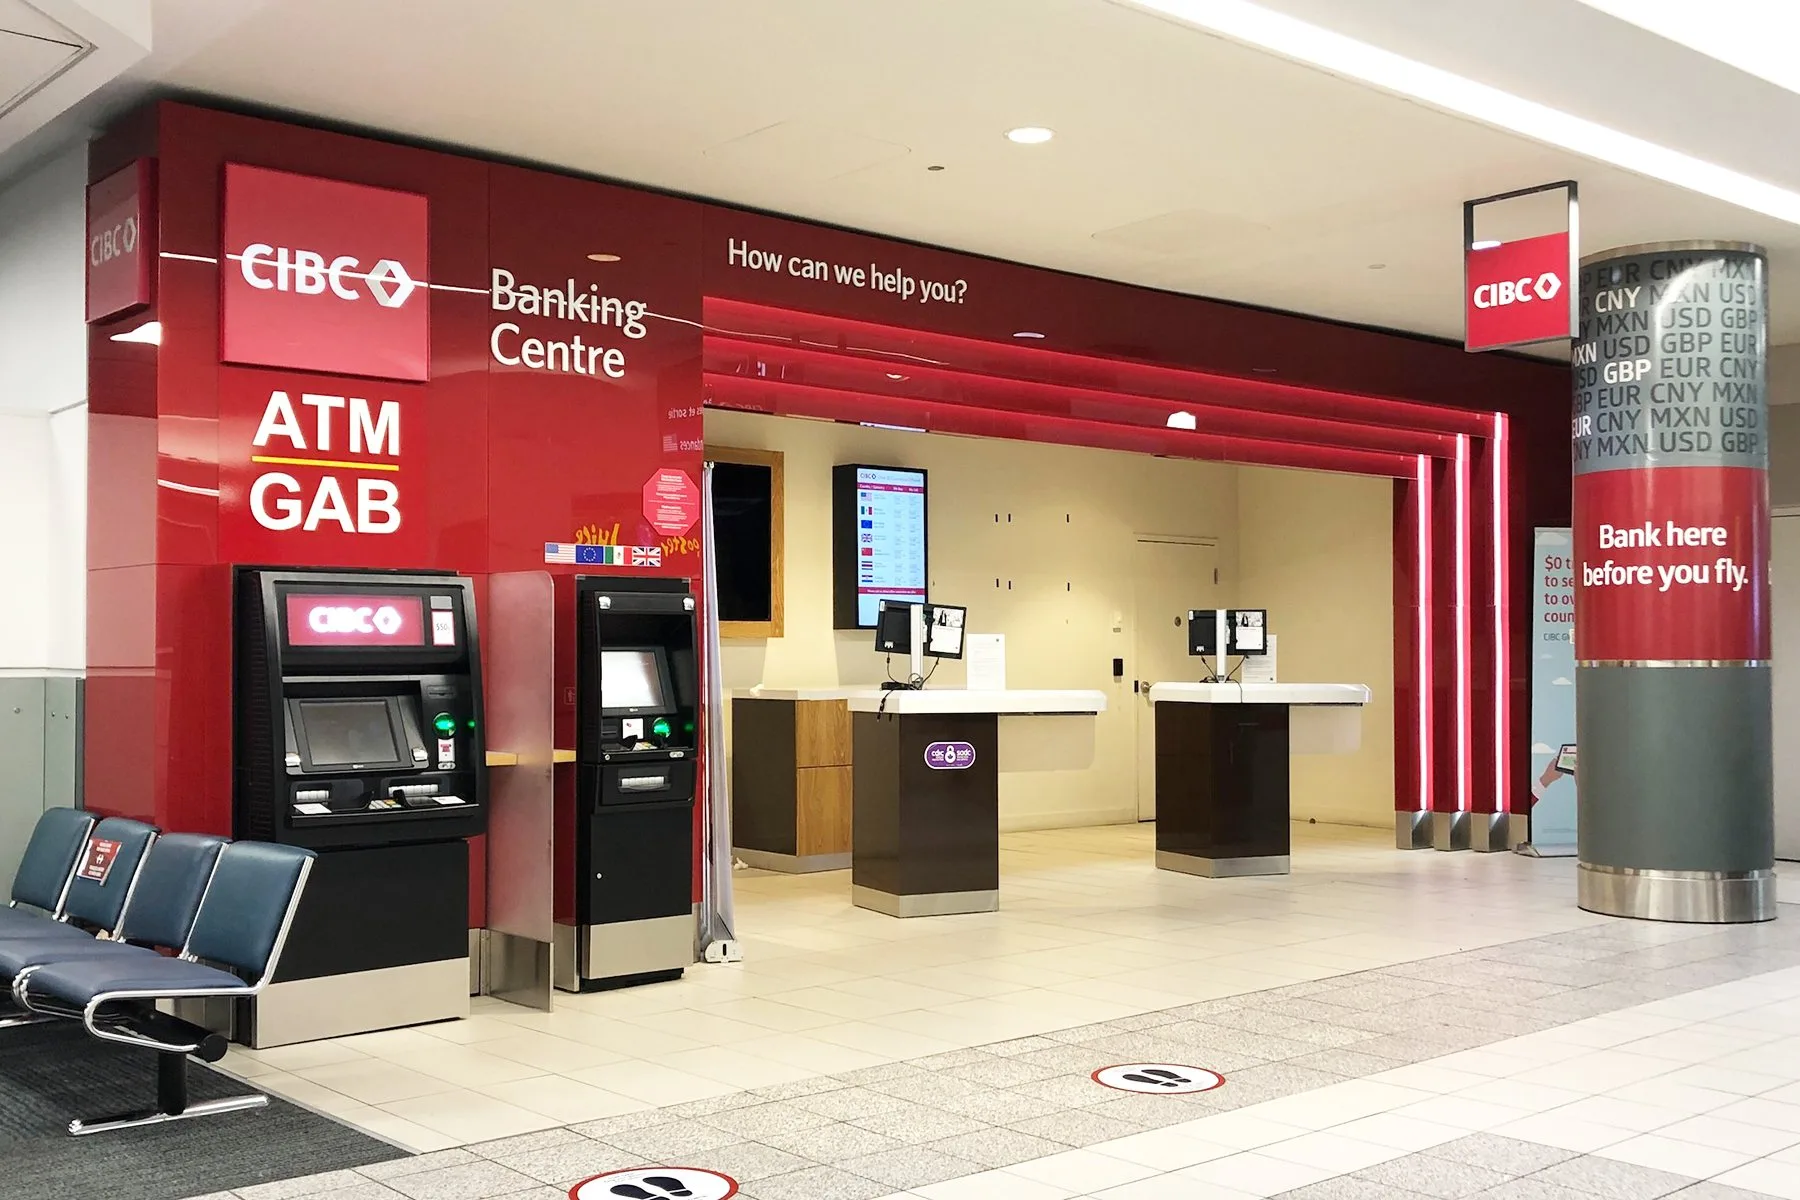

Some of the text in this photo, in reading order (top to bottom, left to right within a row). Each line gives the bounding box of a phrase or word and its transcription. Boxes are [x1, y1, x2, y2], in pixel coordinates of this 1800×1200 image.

[91, 224, 122, 267] CIBC
[241, 243, 360, 301] CIBC
[728, 238, 968, 304] How can we help you?
[1650, 257, 1703, 282] CN
[492, 268, 647, 339] Banking
[1473, 277, 1533, 309] CIBC
[1595, 286, 1641, 313] CNY
[1597, 310, 1648, 335] MXN
[1721, 308, 1757, 330] GBP
[490, 322, 625, 378] Centre
[1604, 335, 1650, 359] USD
[1661, 332, 1712, 354] GBP
[1721, 333, 1757, 355] EUR
[1604, 358, 1651, 385] GBP
[1660, 357, 1711, 379] EUR
[1720, 357, 1758, 380] CNY
[1598, 385, 1641, 410] EUR
[1650, 382, 1704, 405] CNY
[1713, 383, 1758, 405] MXN
[252, 390, 400, 456] ATM
[1596, 409, 1641, 434] CNY
[1651, 406, 1710, 429] MXN
[1720, 407, 1758, 429] USD
[1597, 434, 1649, 458] MXN
[1660, 431, 1712, 453] USD
[1721, 432, 1758, 454] GBP
[249, 472, 401, 534] GAB
[1599, 521, 1727, 549] Bank here
[1545, 555, 1562, 572] $0
[1583, 558, 1749, 592] before you fly.
[1544, 575, 1574, 587] to se
[1544, 593, 1558, 605] to
[1544, 612, 1574, 622] coun
